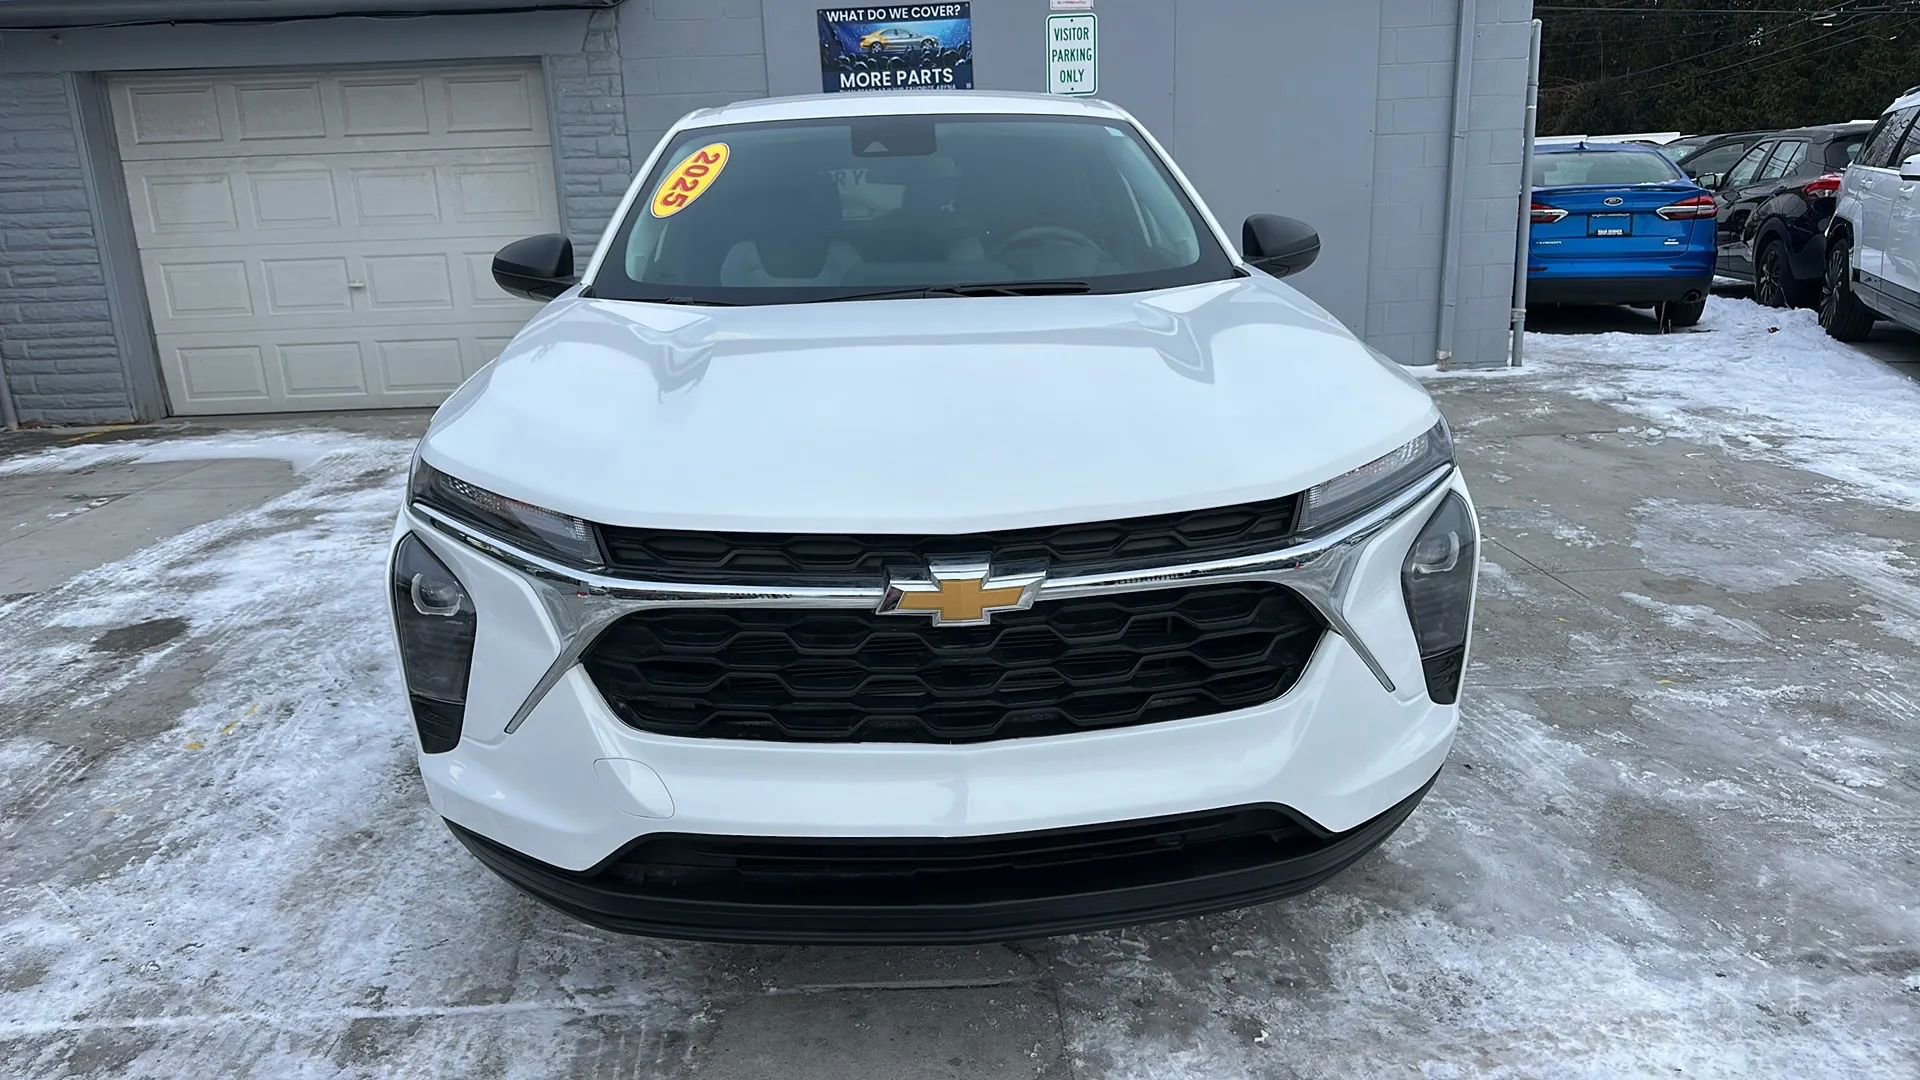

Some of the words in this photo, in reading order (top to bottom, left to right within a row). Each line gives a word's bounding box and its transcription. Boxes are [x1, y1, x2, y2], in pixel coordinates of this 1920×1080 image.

[826, 10, 864, 22] WHAT
[868, 9, 886, 20] DO
[889, 8, 908, 19] WE
[911, 5, 961, 18] COVER?
[1054, 27, 1089, 41] VISITOR
[1052, 48, 1092, 62] PARKING
[840, 72, 891, 88] MORE
[897, 68, 953, 85] PARTS
[1060, 69, 1084, 83] ONLY
[661, 151, 720, 207] 2025
